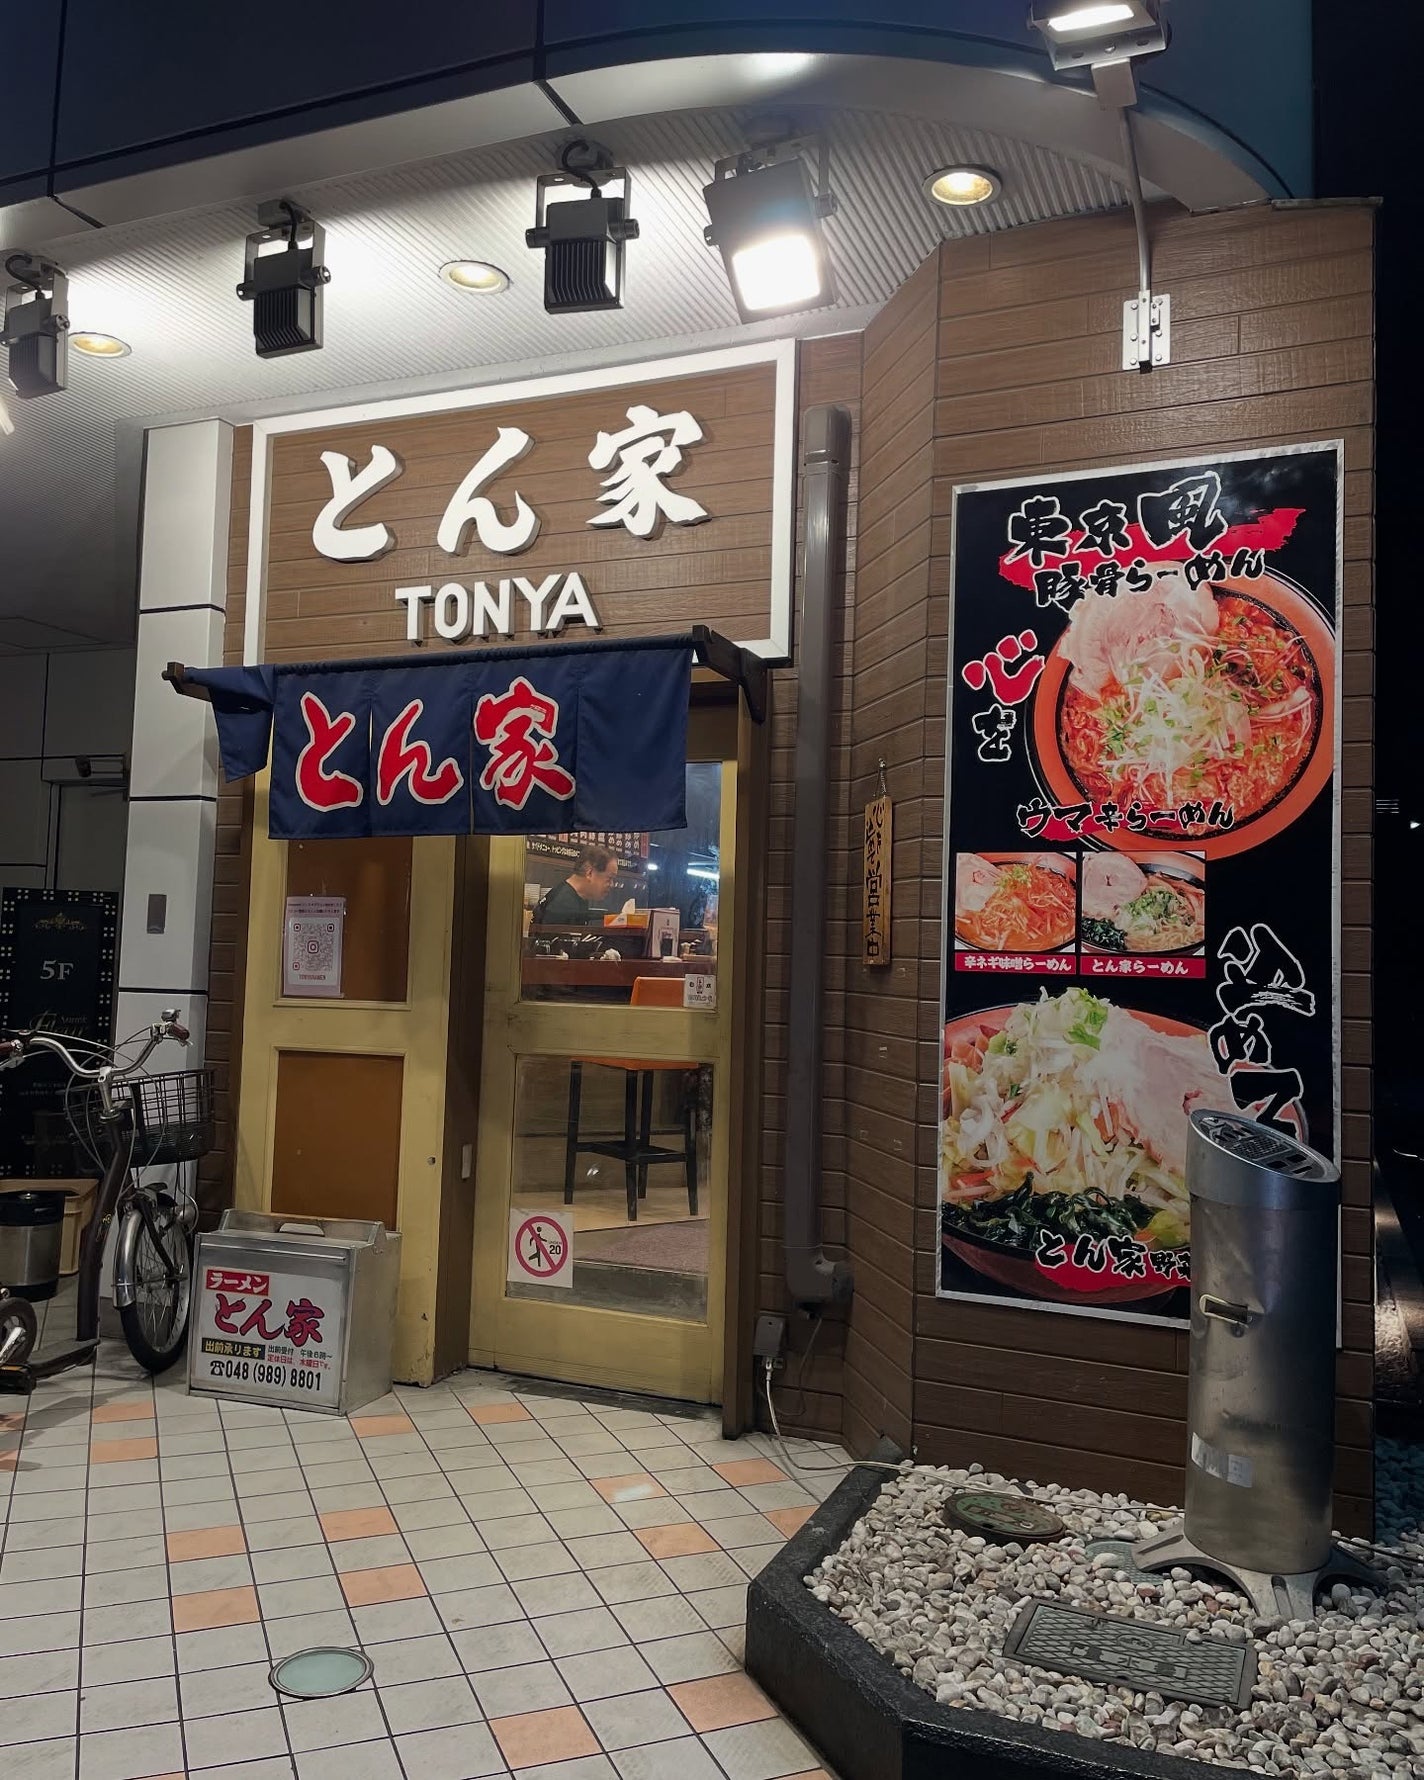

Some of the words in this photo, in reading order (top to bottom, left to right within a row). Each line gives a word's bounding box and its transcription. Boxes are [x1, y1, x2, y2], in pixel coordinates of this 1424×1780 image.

[312, 404, 712, 560] とん家
[1004, 471, 1228, 567] 東京風
[1033, 547, 1266, 614] 豚骨らーめん
[395, 572, 600, 644] TONYA
[296, 676, 576, 812] とん家
[1014, 798, 1236, 838] ウマ辛らーめん
[40, 960, 74, 980] 5F
[963, 955, 1072, 972] 辛ネギ味噌らーめん
[1092, 958, 1189, 976] とん家らーめん
[549, 1244, 562, 1255] 20
[210, 1272, 267, 1293] ラーメン
[214, 1293, 325, 1347] とん家
[205, 1341, 262, 1358] 出前承ります
[225, 1360, 249, 1380] 048
[253, 1363, 287, 1387] (989)
[290, 1367, 322, 1391] 8801
